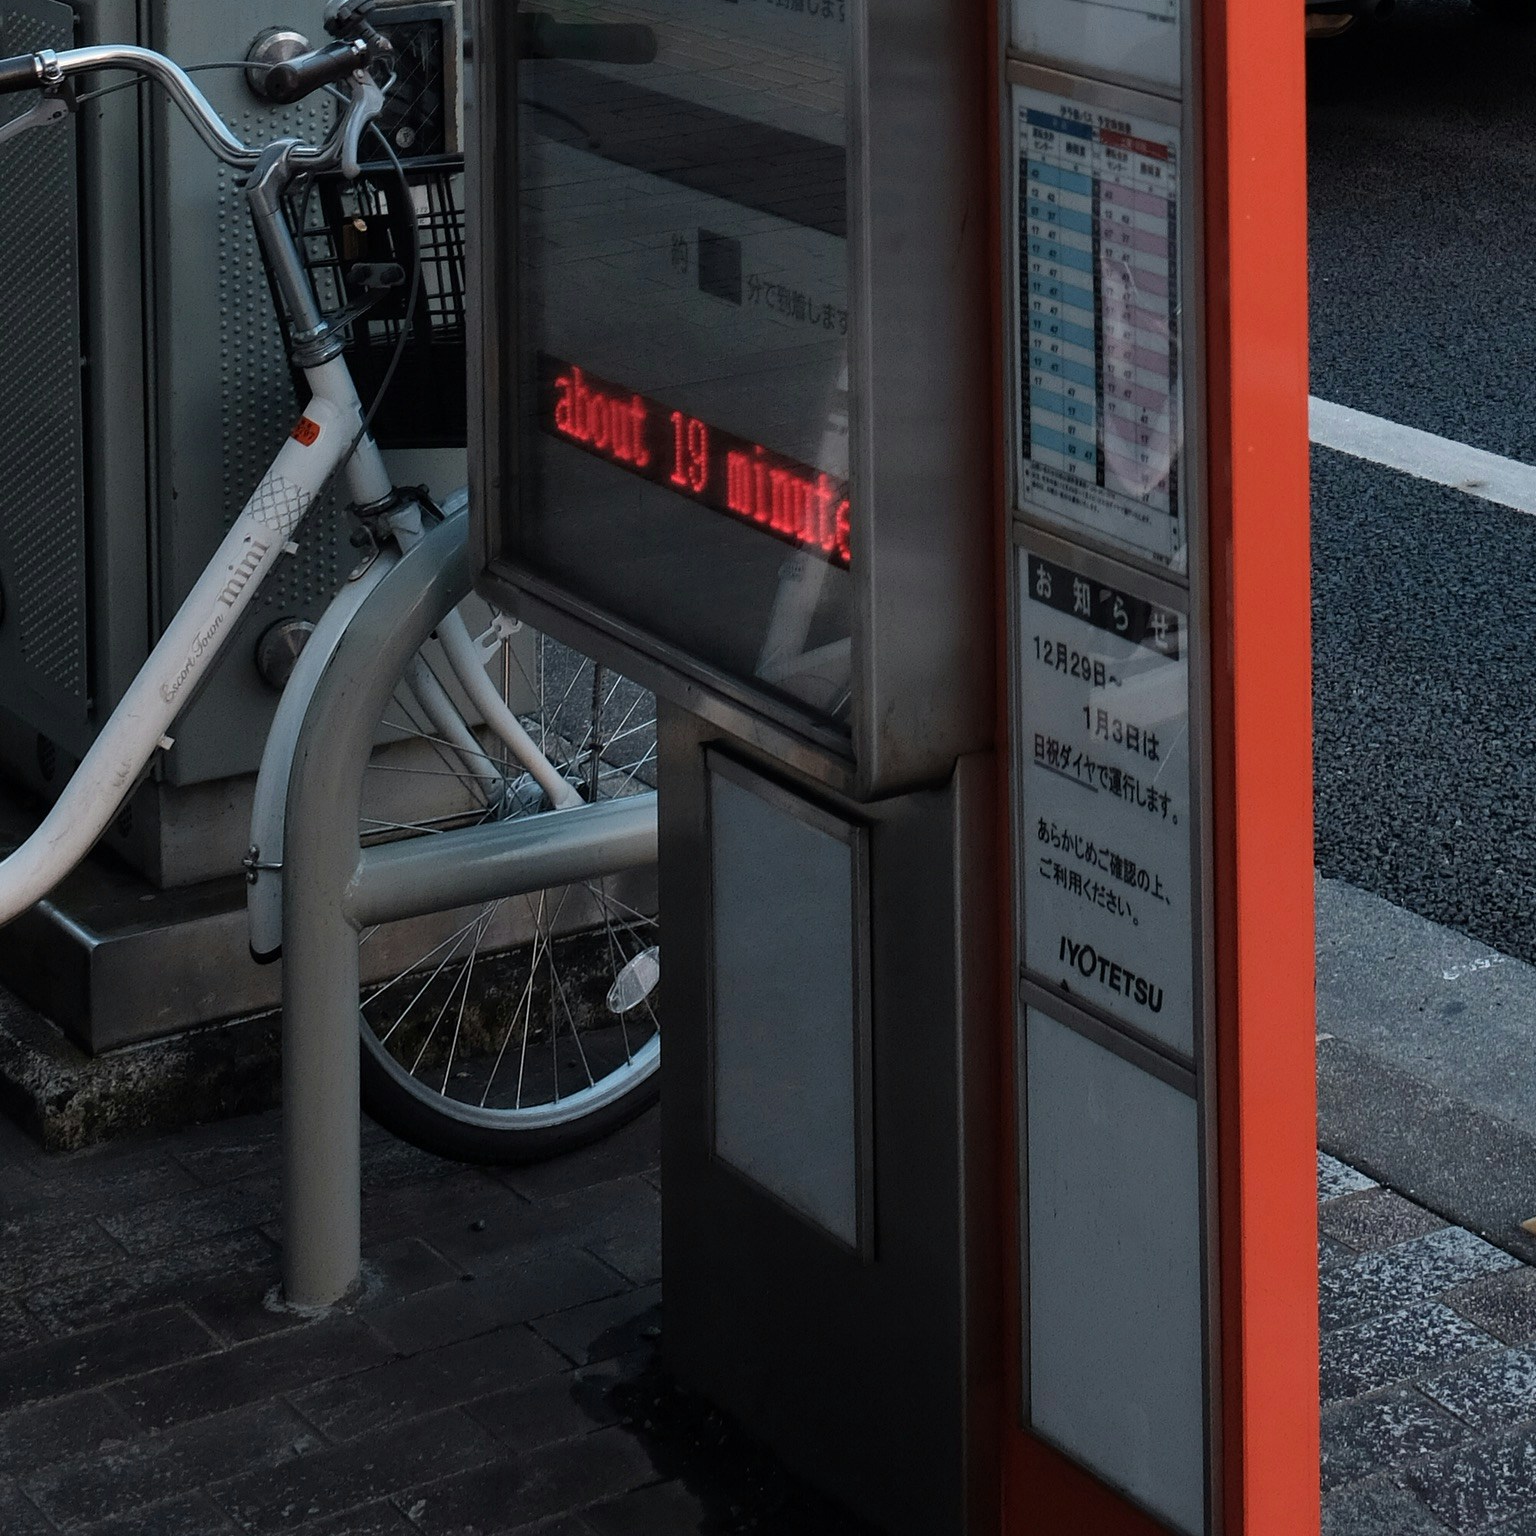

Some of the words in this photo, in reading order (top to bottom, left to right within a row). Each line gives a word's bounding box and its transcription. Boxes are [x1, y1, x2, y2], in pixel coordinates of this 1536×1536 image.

[555, 365, 650, 468] about
[671, 411, 708, 492] 19
[1036, 564, 1169, 649] お知らせ
[1034, 635, 1122, 689] 12月29日〜
[1083, 706, 1160, 762] 1月3日は
[1037, 816, 1172, 906] あらかじめご確認の上、
[1039, 856, 1140, 926] ご利用ください。
[1060, 936, 1163, 1013] IYOTETSU
